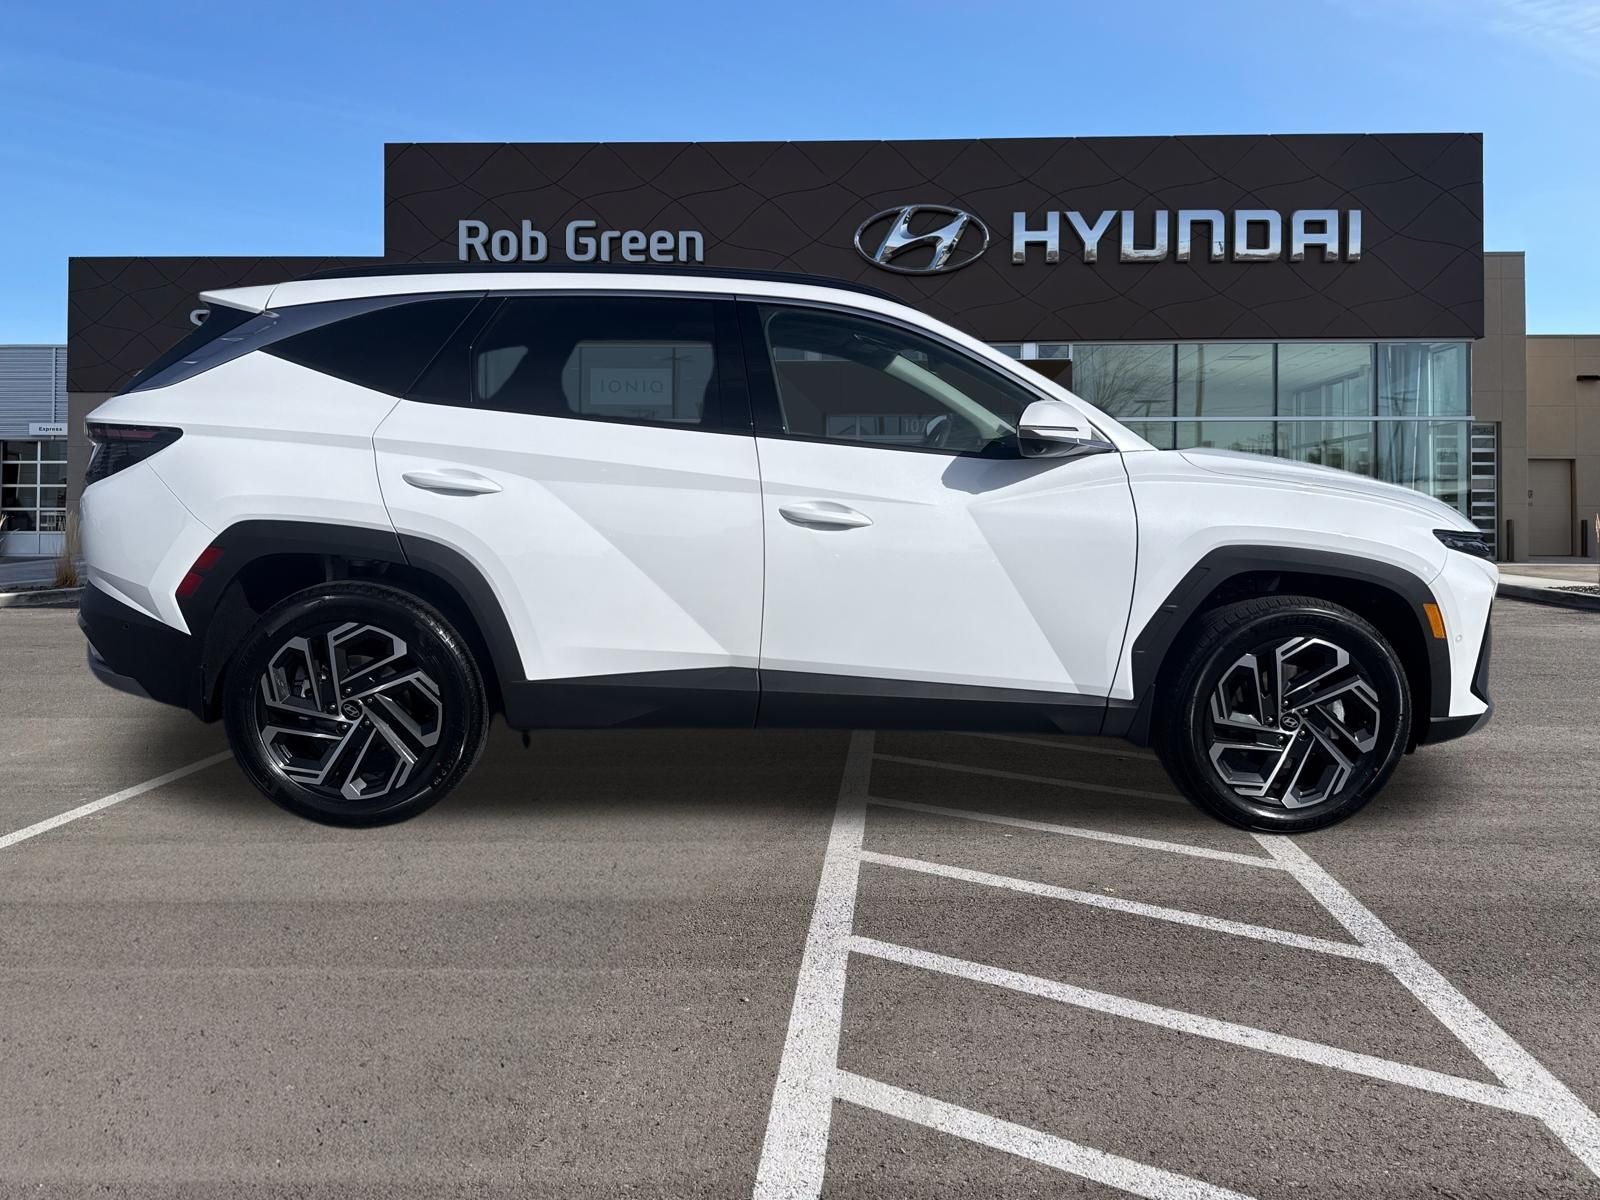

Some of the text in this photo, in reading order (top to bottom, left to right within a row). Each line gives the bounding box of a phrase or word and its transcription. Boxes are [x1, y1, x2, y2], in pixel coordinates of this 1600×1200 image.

[458, 219, 704, 263] Rob Green
[1011, 209, 1363, 264] HYUNDAI
[600, 379, 664, 393] IONIQ
